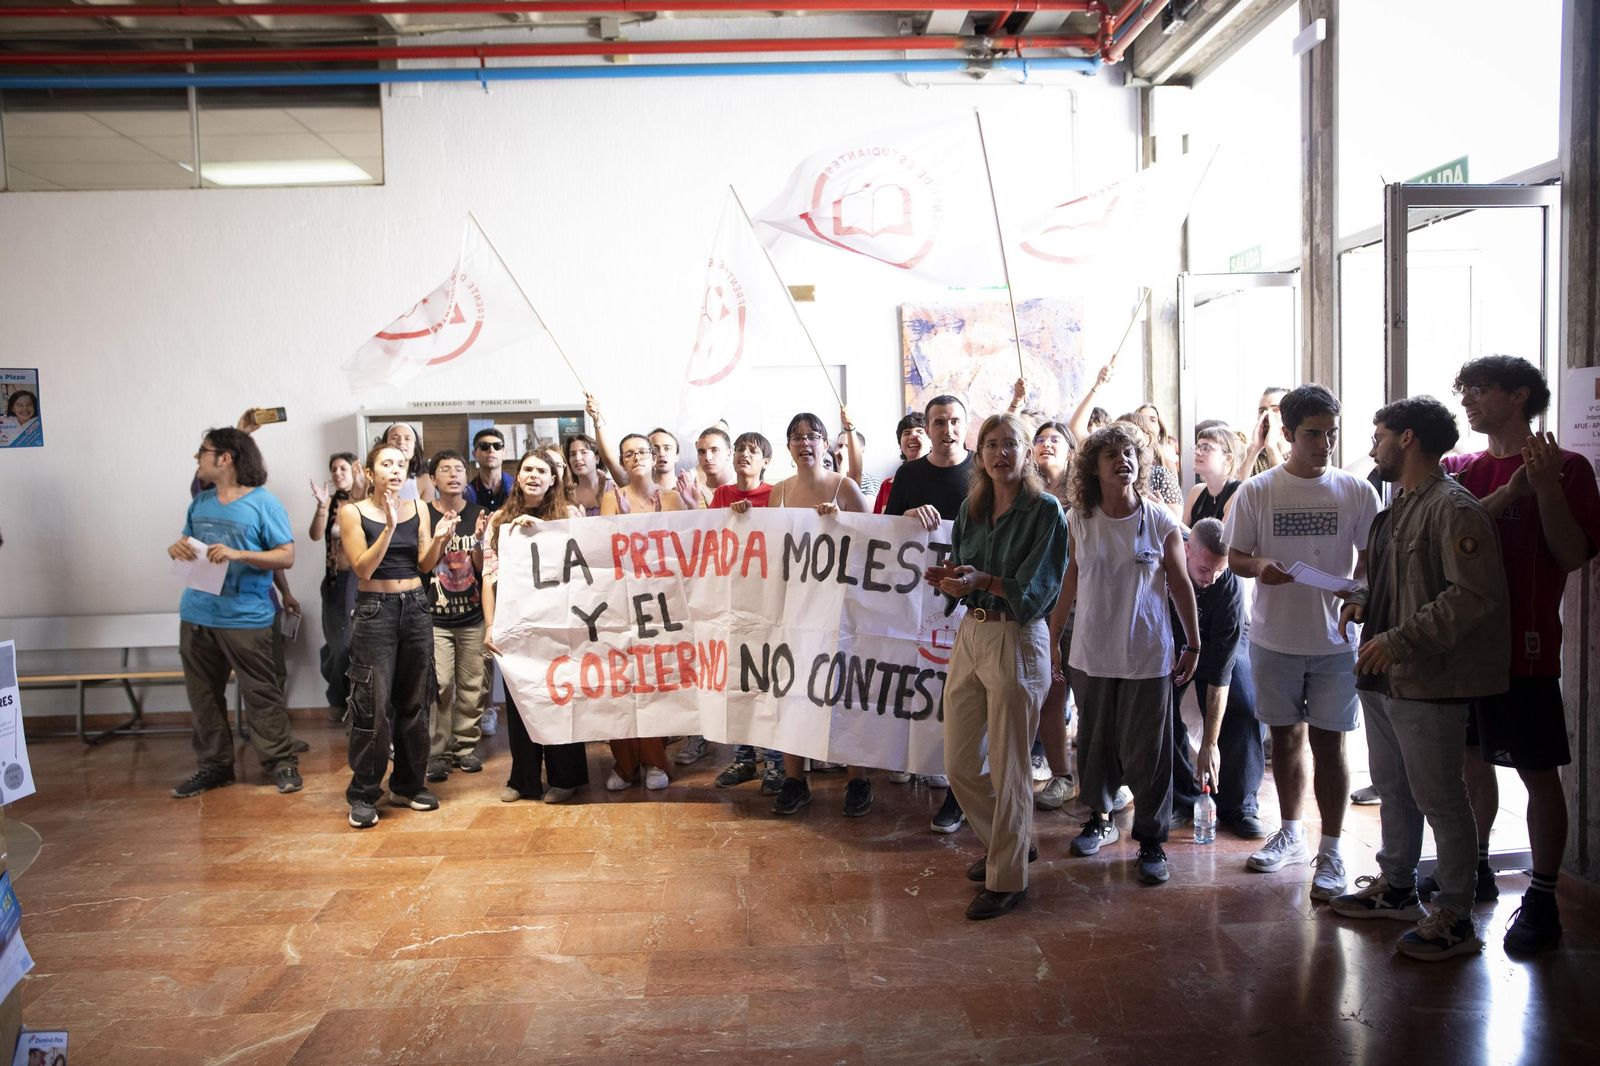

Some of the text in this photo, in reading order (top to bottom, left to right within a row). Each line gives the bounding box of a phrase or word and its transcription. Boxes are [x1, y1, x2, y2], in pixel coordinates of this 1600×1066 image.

[412, 400, 463, 408] SECRETARIADO
[530, 538, 593, 589] LA
[611, 528, 768, 581] PRIVADA
[783, 532, 952, 597] MOLEST
[571, 592, 684, 642] Y EL
[546, 639, 947, 722] GOBIERNO NO CONTEST
